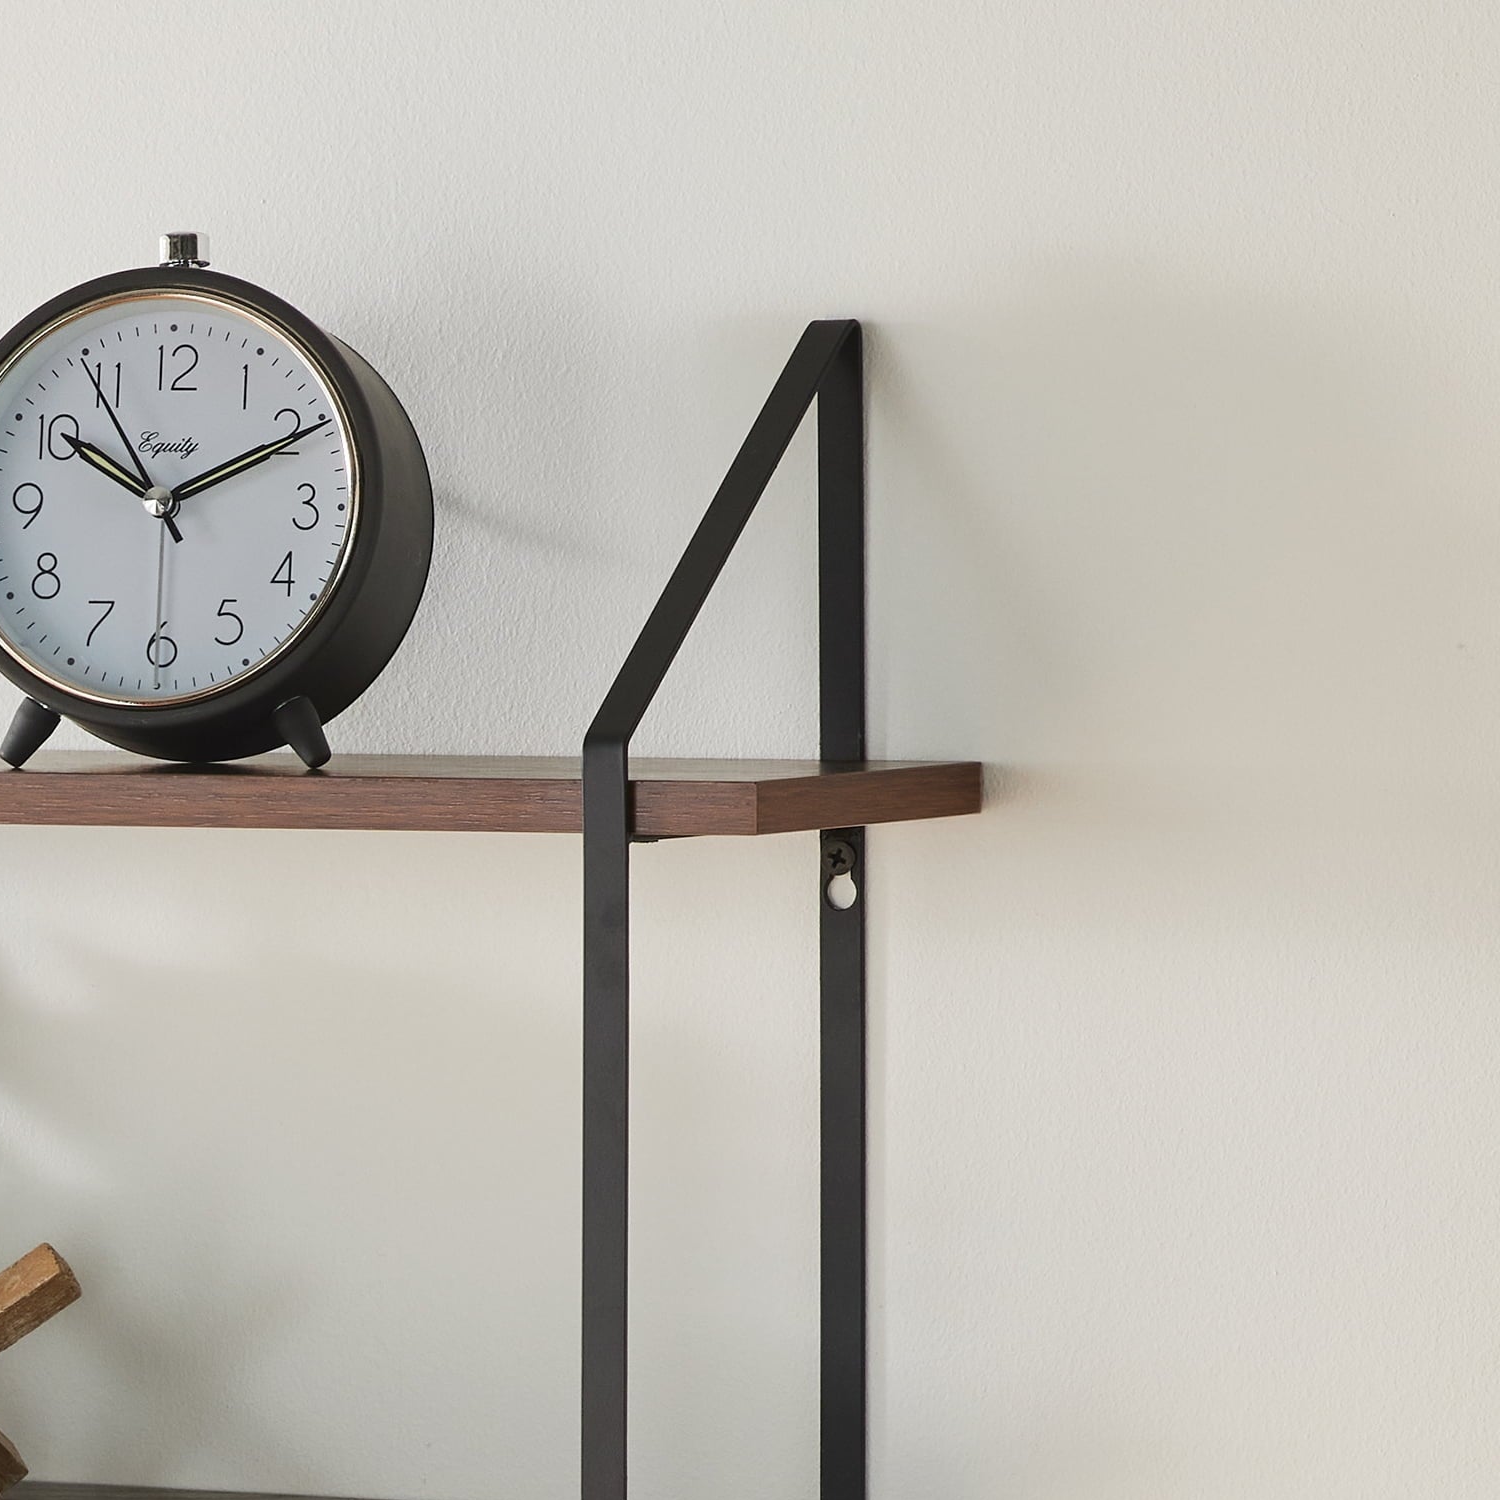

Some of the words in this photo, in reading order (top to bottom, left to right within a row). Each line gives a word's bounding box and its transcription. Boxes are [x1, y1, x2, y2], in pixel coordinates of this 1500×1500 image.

[95, 361, 121, 408] 11
[157, 343, 199, 391] 12
[241, 364, 249, 410] 1
[38, 414, 80, 460] 10
[137, 430, 200, 459] Equity
[273, 408, 300, 455] 2
[12, 483, 44, 529] 9
[291, 483, 320, 530] 3
[31, 552, 61, 599] 8
[270, 550, 295, 597] 4
[88, 600, 115, 646] 7
[146, 621, 177, 668] 6
[214, 599, 244, 645] 5
